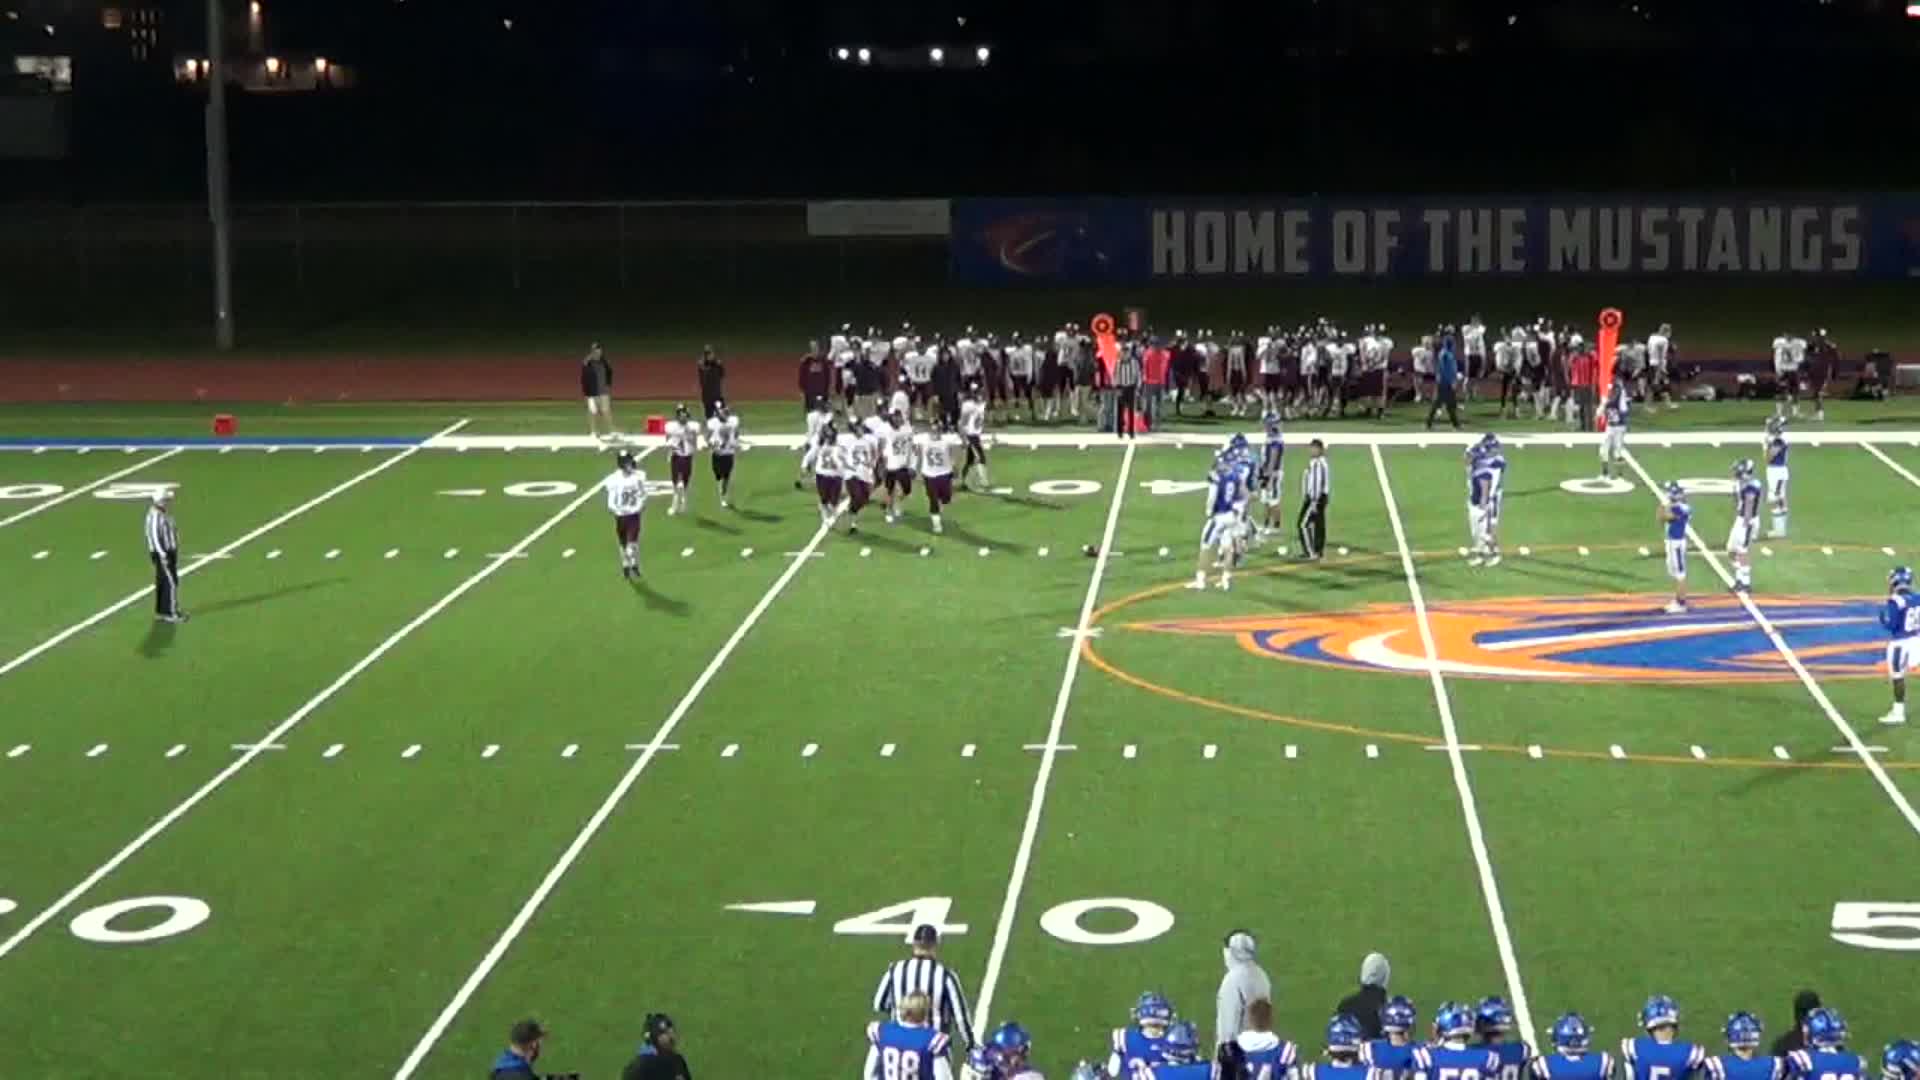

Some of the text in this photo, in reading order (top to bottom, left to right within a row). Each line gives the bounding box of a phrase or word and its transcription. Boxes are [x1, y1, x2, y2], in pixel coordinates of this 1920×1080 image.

[1152, 206, 1861, 273] HOME OF THE MUSTANGS
[882, 1046, 919, 1080] 88
